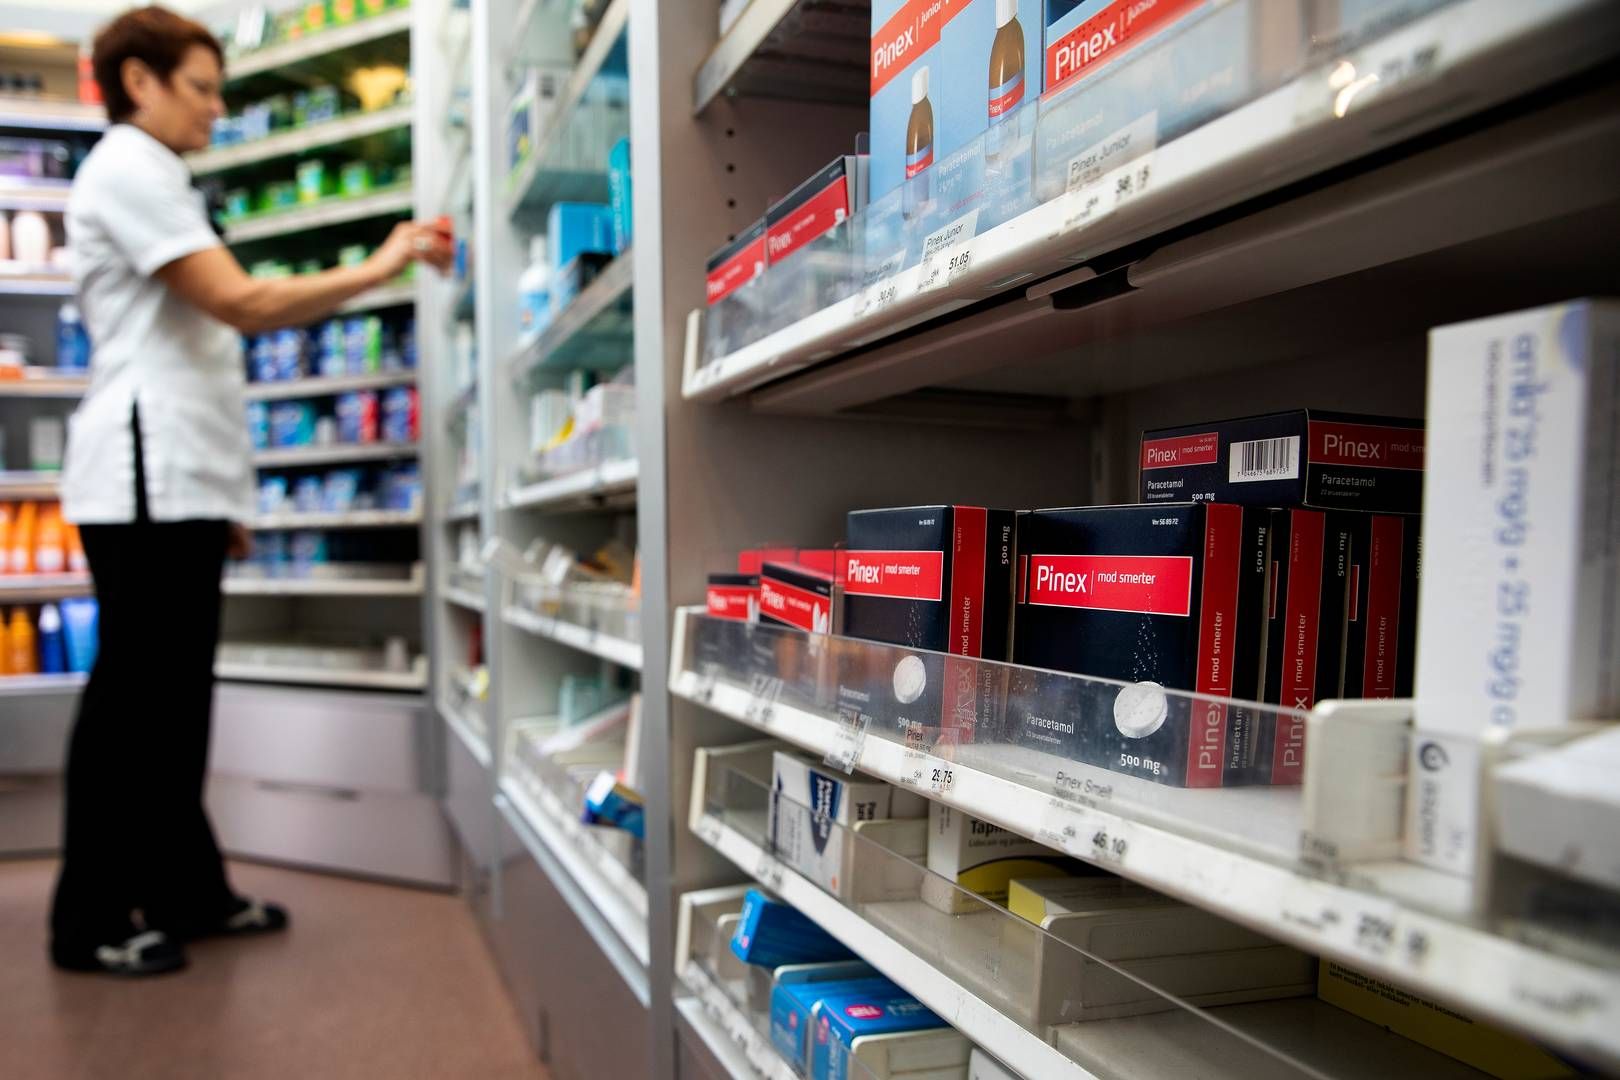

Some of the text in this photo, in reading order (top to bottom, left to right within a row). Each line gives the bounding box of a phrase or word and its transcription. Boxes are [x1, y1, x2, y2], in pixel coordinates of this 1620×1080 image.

[873, 2, 942, 78] Pinex junior
[1055, 22, 1117, 80] Pinex
[1071, 133, 1131, 174] Pinex Junior
[926, 223, 964, 248] Pinex Junior
[948, 250, 970, 271] 51.05
[1147, 448, 1177, 463] Pinex
[1182, 446, 1193, 454] mod
[1323, 433, 1380, 459] Pinex
[1390, 442, 1409, 453] mod
[1147, 478, 1184, 490] Paracetamol
[1321, 474, 1376, 487] Paracetamol
[1191, 492, 1216, 504] 500 mg
[1001, 525, 1011, 565] 500 mg
[1256, 527, 1266, 573] 500 mg
[1337, 532, 1347, 577] 500 mg
[847, 559, 921, 584] Pinex mod smerter
[1036, 564, 1156, 593] Pinex mod smerter
[963, 596, 971, 623] smerter
[961, 624, 970, 657] mod
[1213, 611, 1223, 655] smerter
[1297, 613, 1307, 655] smerter
[1375, 616, 1387, 683] mod smerter
[1211, 657, 1220, 683] mod
[1295, 658, 1304, 683] mod
[981, 669, 992, 728] Paracetamol
[907, 728, 924, 742] Pinex
[1026, 712, 1075, 735] Paracetamol
[931, 768, 953, 784] 29.75
[1120, 753, 1161, 775] 500 mg
[1055, 771, 1081, 790] Pinex
[1084, 778, 1113, 798] Smelt
